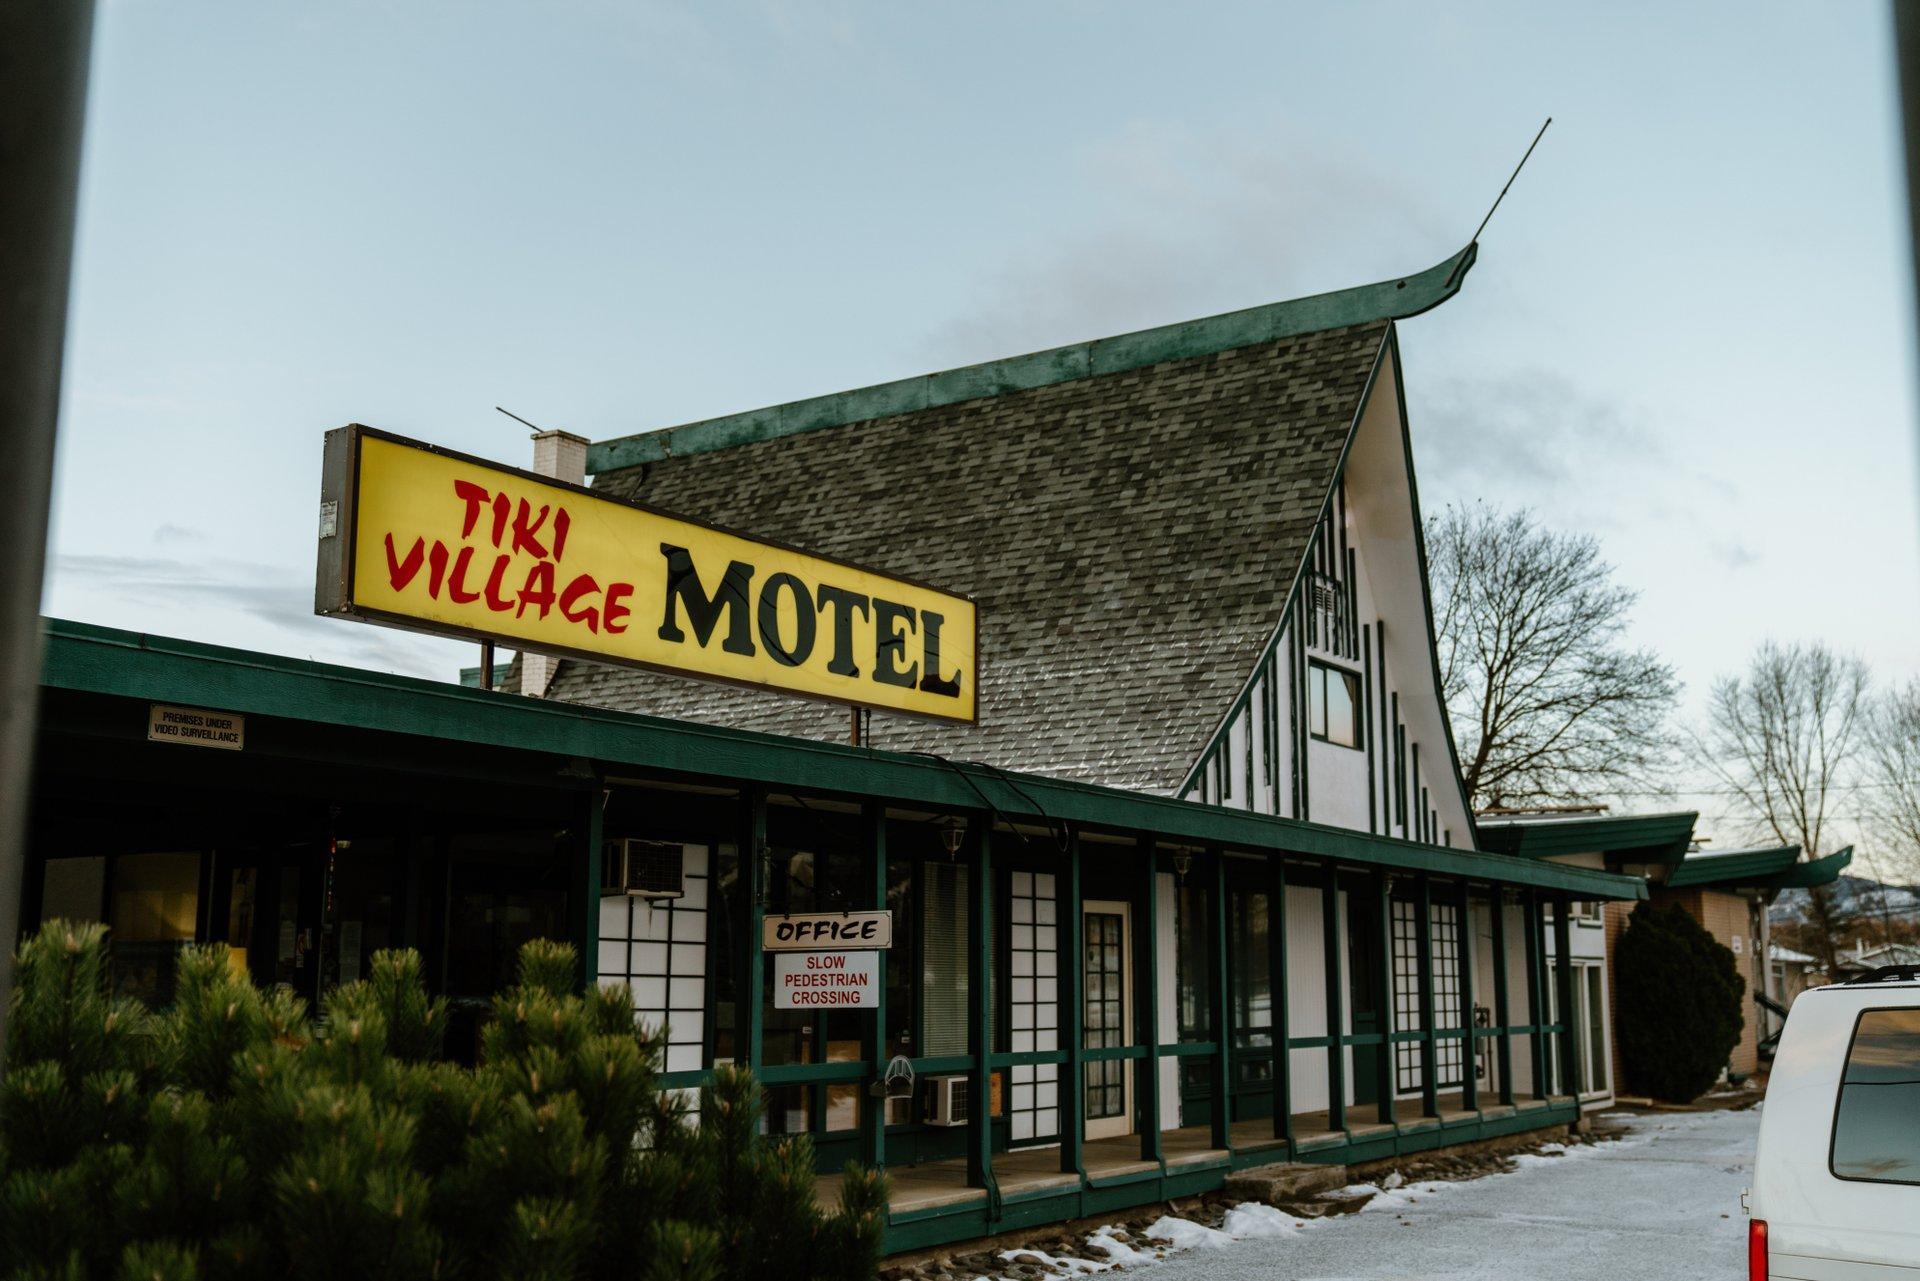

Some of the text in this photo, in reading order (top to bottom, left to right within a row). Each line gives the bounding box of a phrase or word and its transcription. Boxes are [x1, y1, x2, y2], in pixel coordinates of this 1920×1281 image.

[454, 480, 570, 562] TIKI
[384, 532, 634, 634] VILLAGE
[658, 543, 961, 698] MOTEL
[163, 712, 232, 729] PREMISES UNDER
[155, 724, 239, 742] VIDEO SURVEILLANCE
[776, 920, 878, 942] OFFICE
[807, 956, 845, 969] SLOW
[785, 973, 868, 987] PEDESTRIAN
[792, 991, 860, 1004] CROSSING
